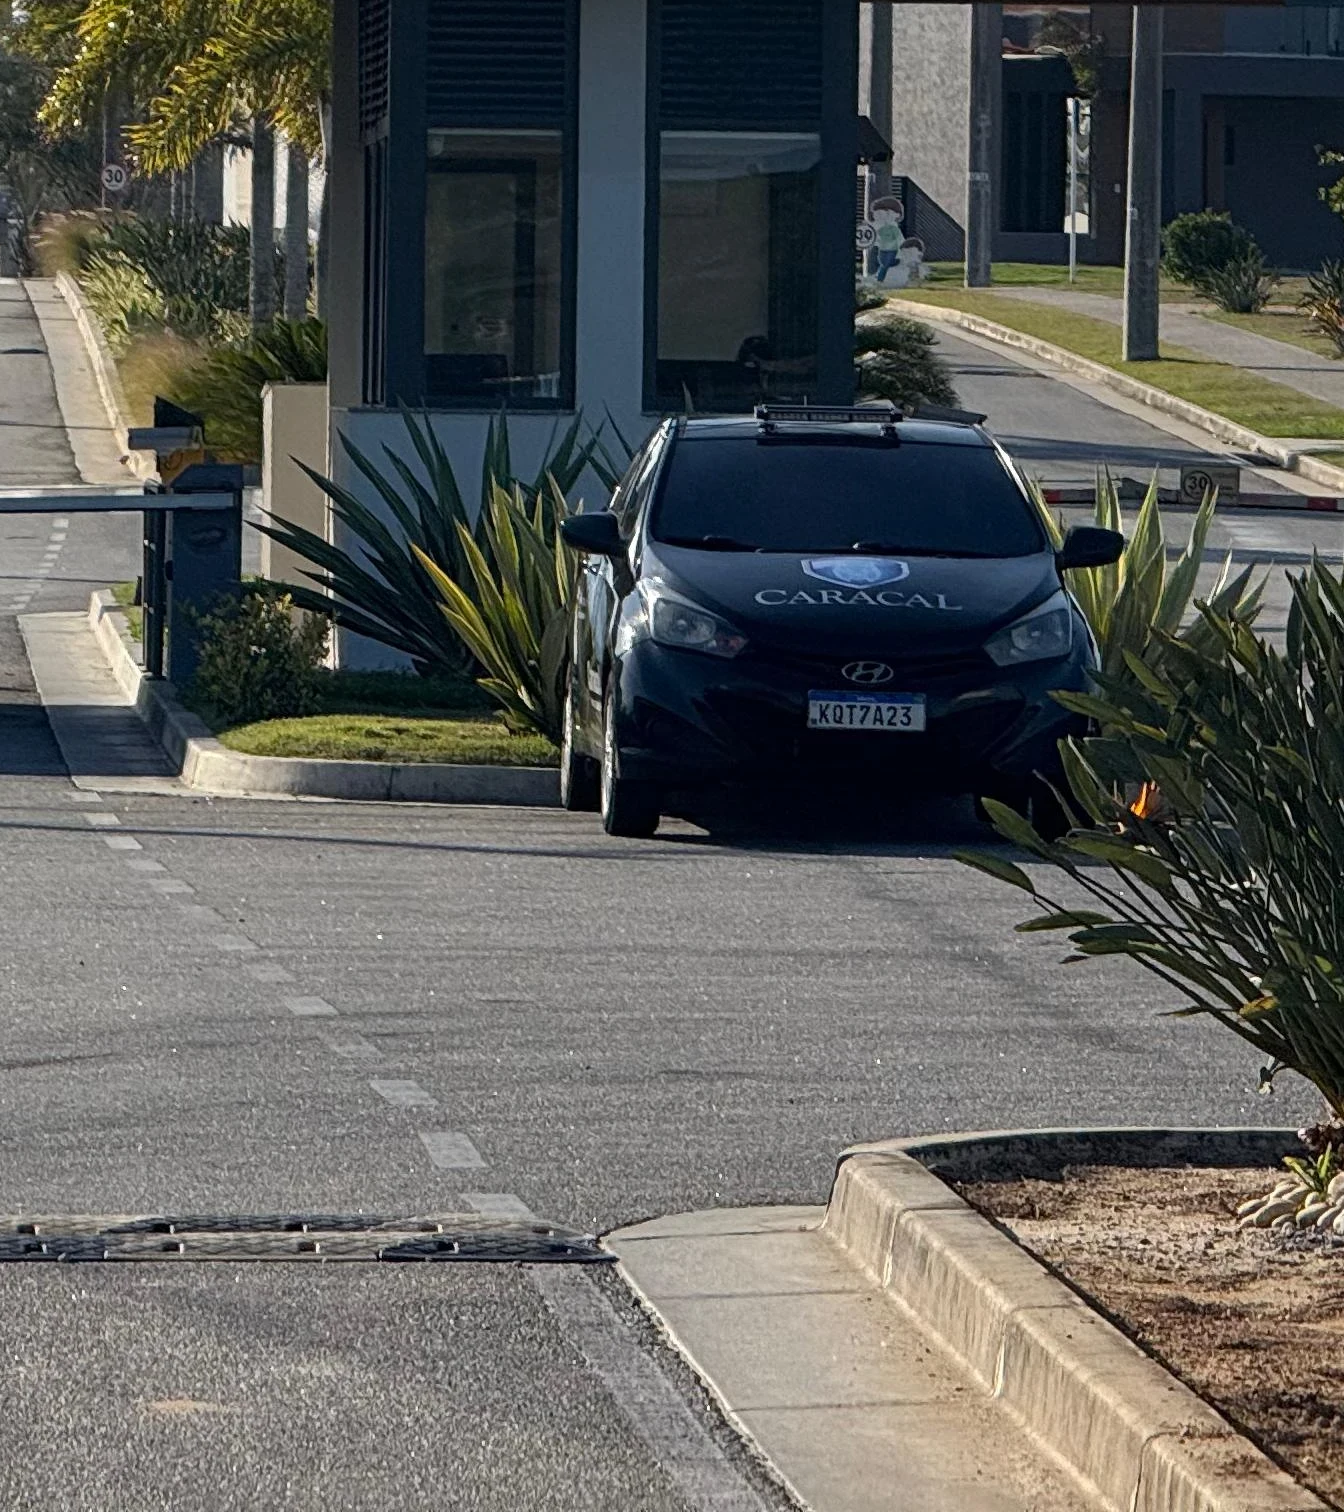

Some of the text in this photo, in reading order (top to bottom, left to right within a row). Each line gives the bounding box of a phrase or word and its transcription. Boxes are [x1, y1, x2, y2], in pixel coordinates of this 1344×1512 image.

[105, 169, 123, 183] 30
[1188, 475, 1208, 490] 30
[755, 589, 963, 611] CARACAL
[818, 703, 913, 727] KQT7A23
